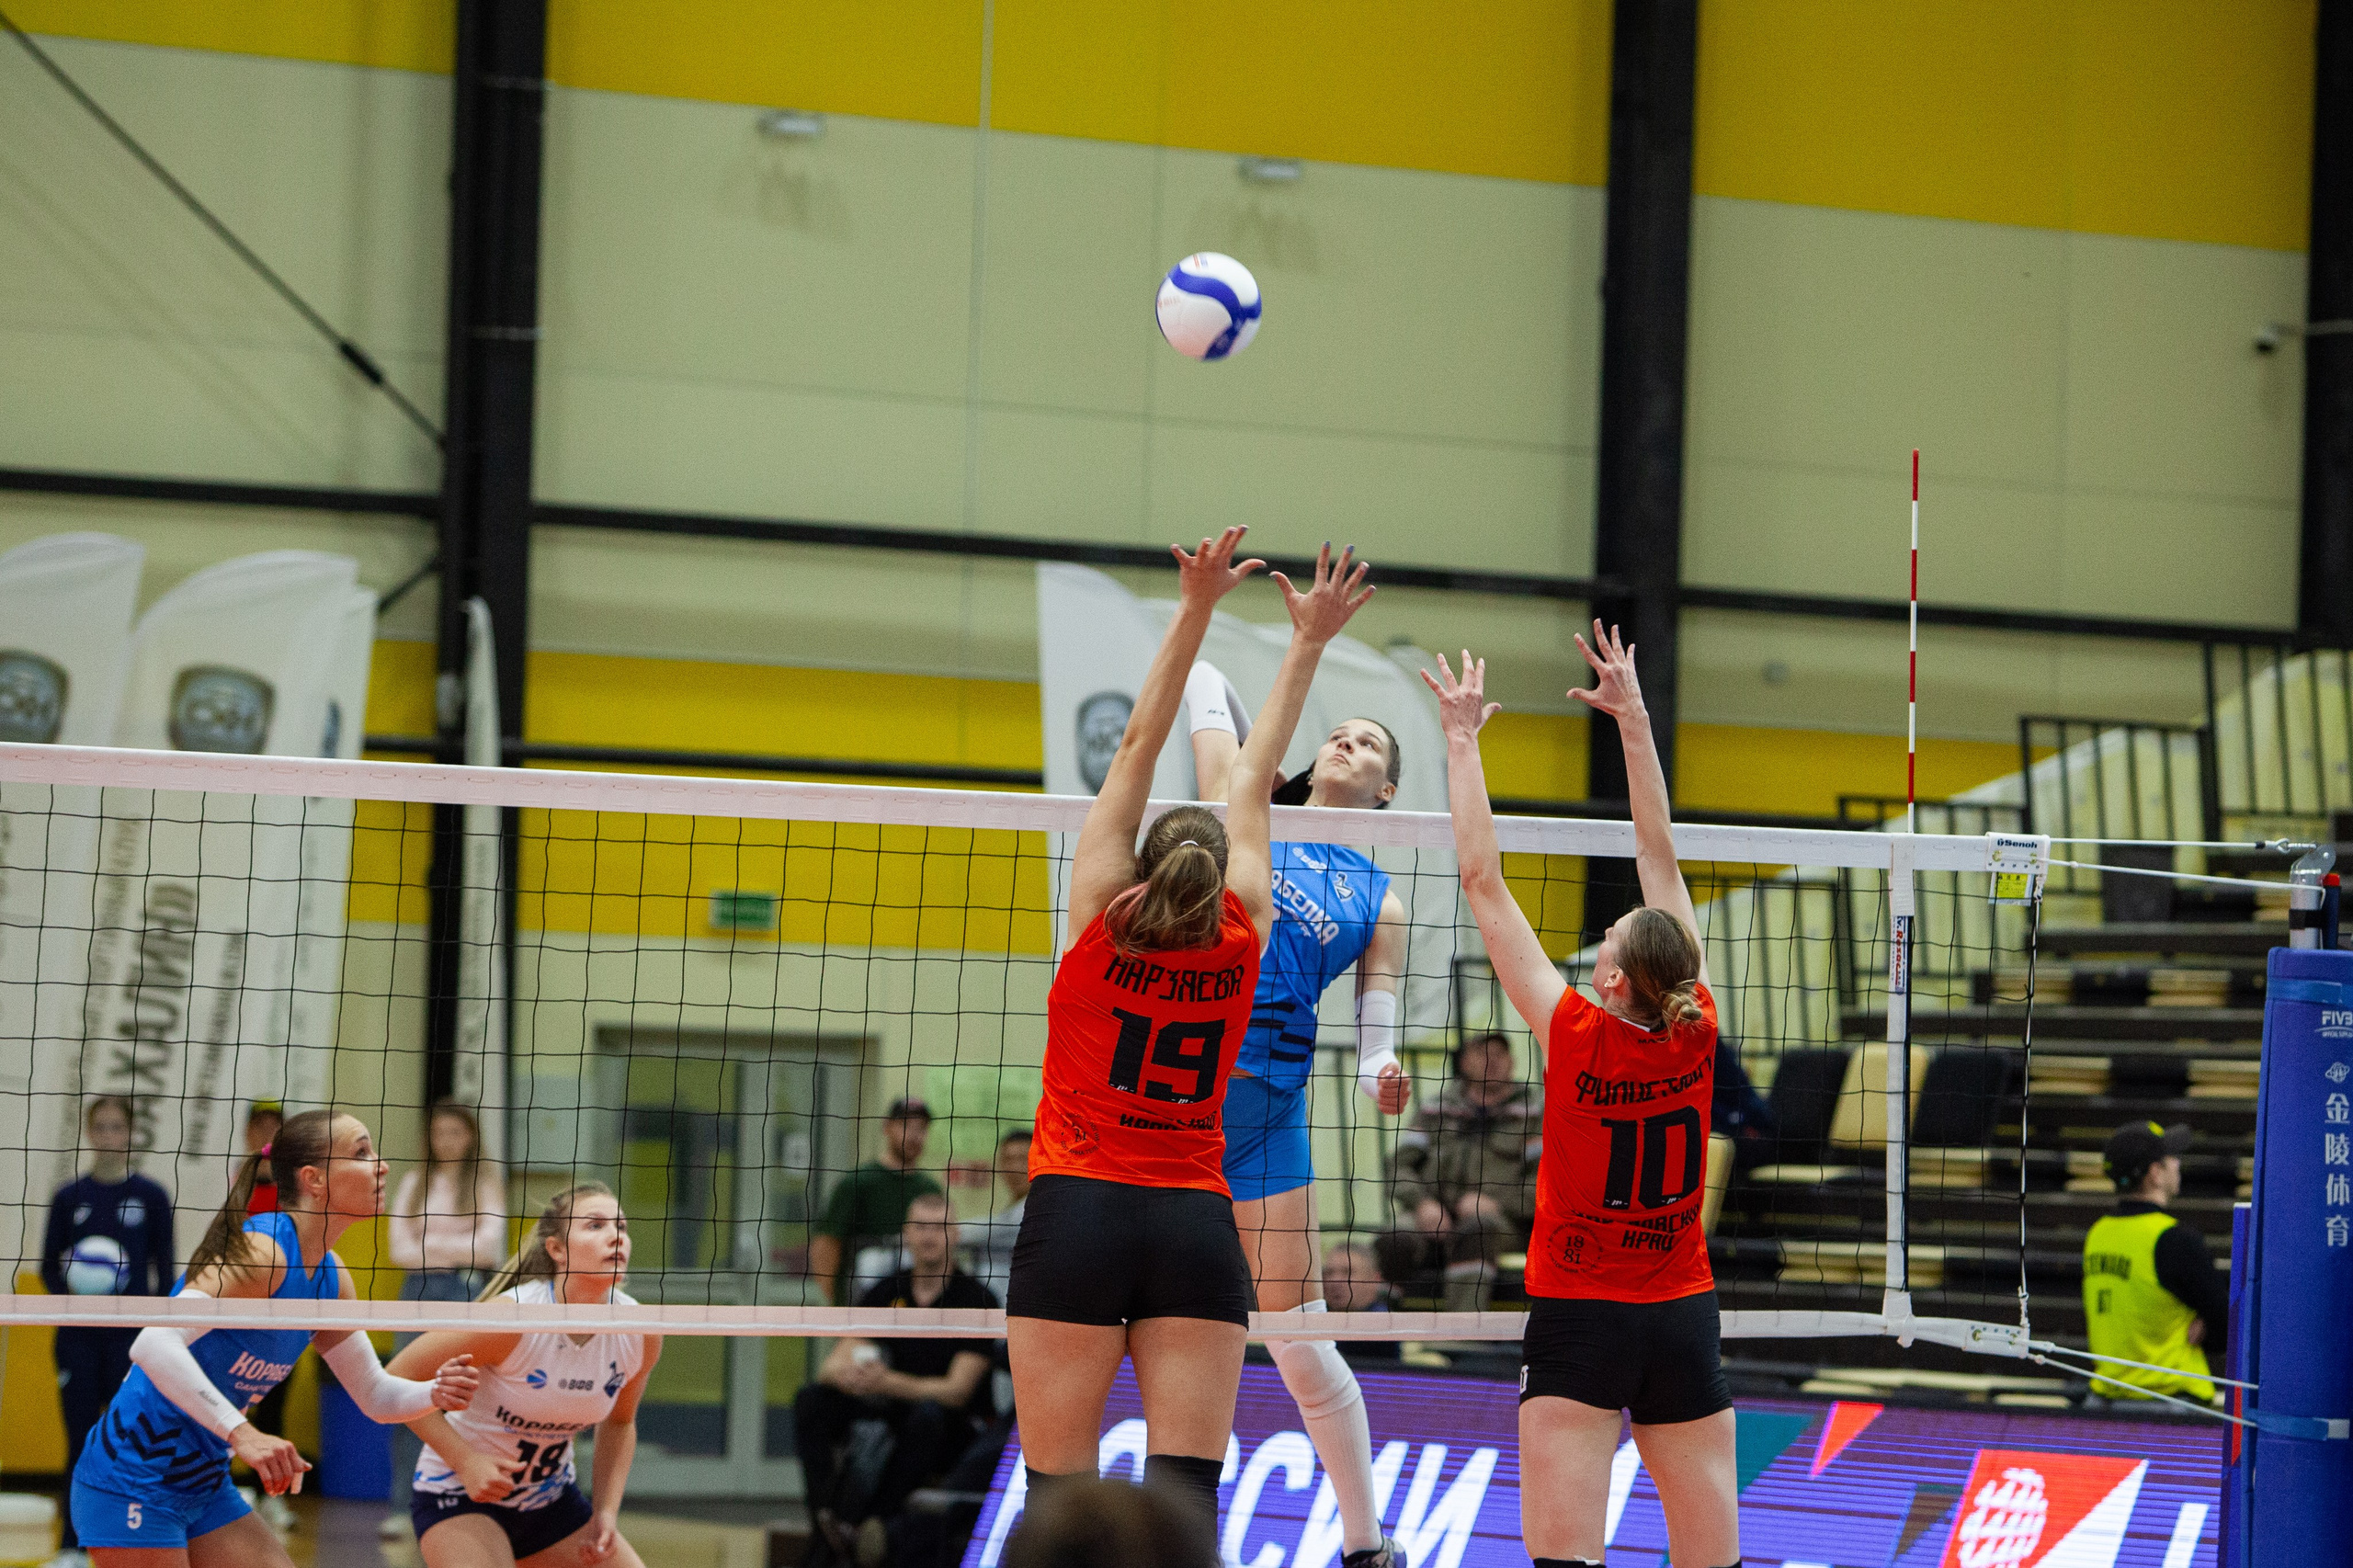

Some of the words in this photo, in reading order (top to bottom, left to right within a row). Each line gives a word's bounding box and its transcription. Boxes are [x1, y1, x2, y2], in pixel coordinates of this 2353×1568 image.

[2005, 839, 2038, 848] Senoh
[1103, 955, 1245, 1003] НАРЗЯЕВА
[1108, 1006, 1226, 1104] 19
[1601, 1105, 1702, 1210] 10
[2325, 1093, 2351, 1247] 金陵体育
[1563, 1248, 1581, 1265] 81
[1565, 1235, 1585, 1248] 18
[127, 1503, 142, 1529] 5
